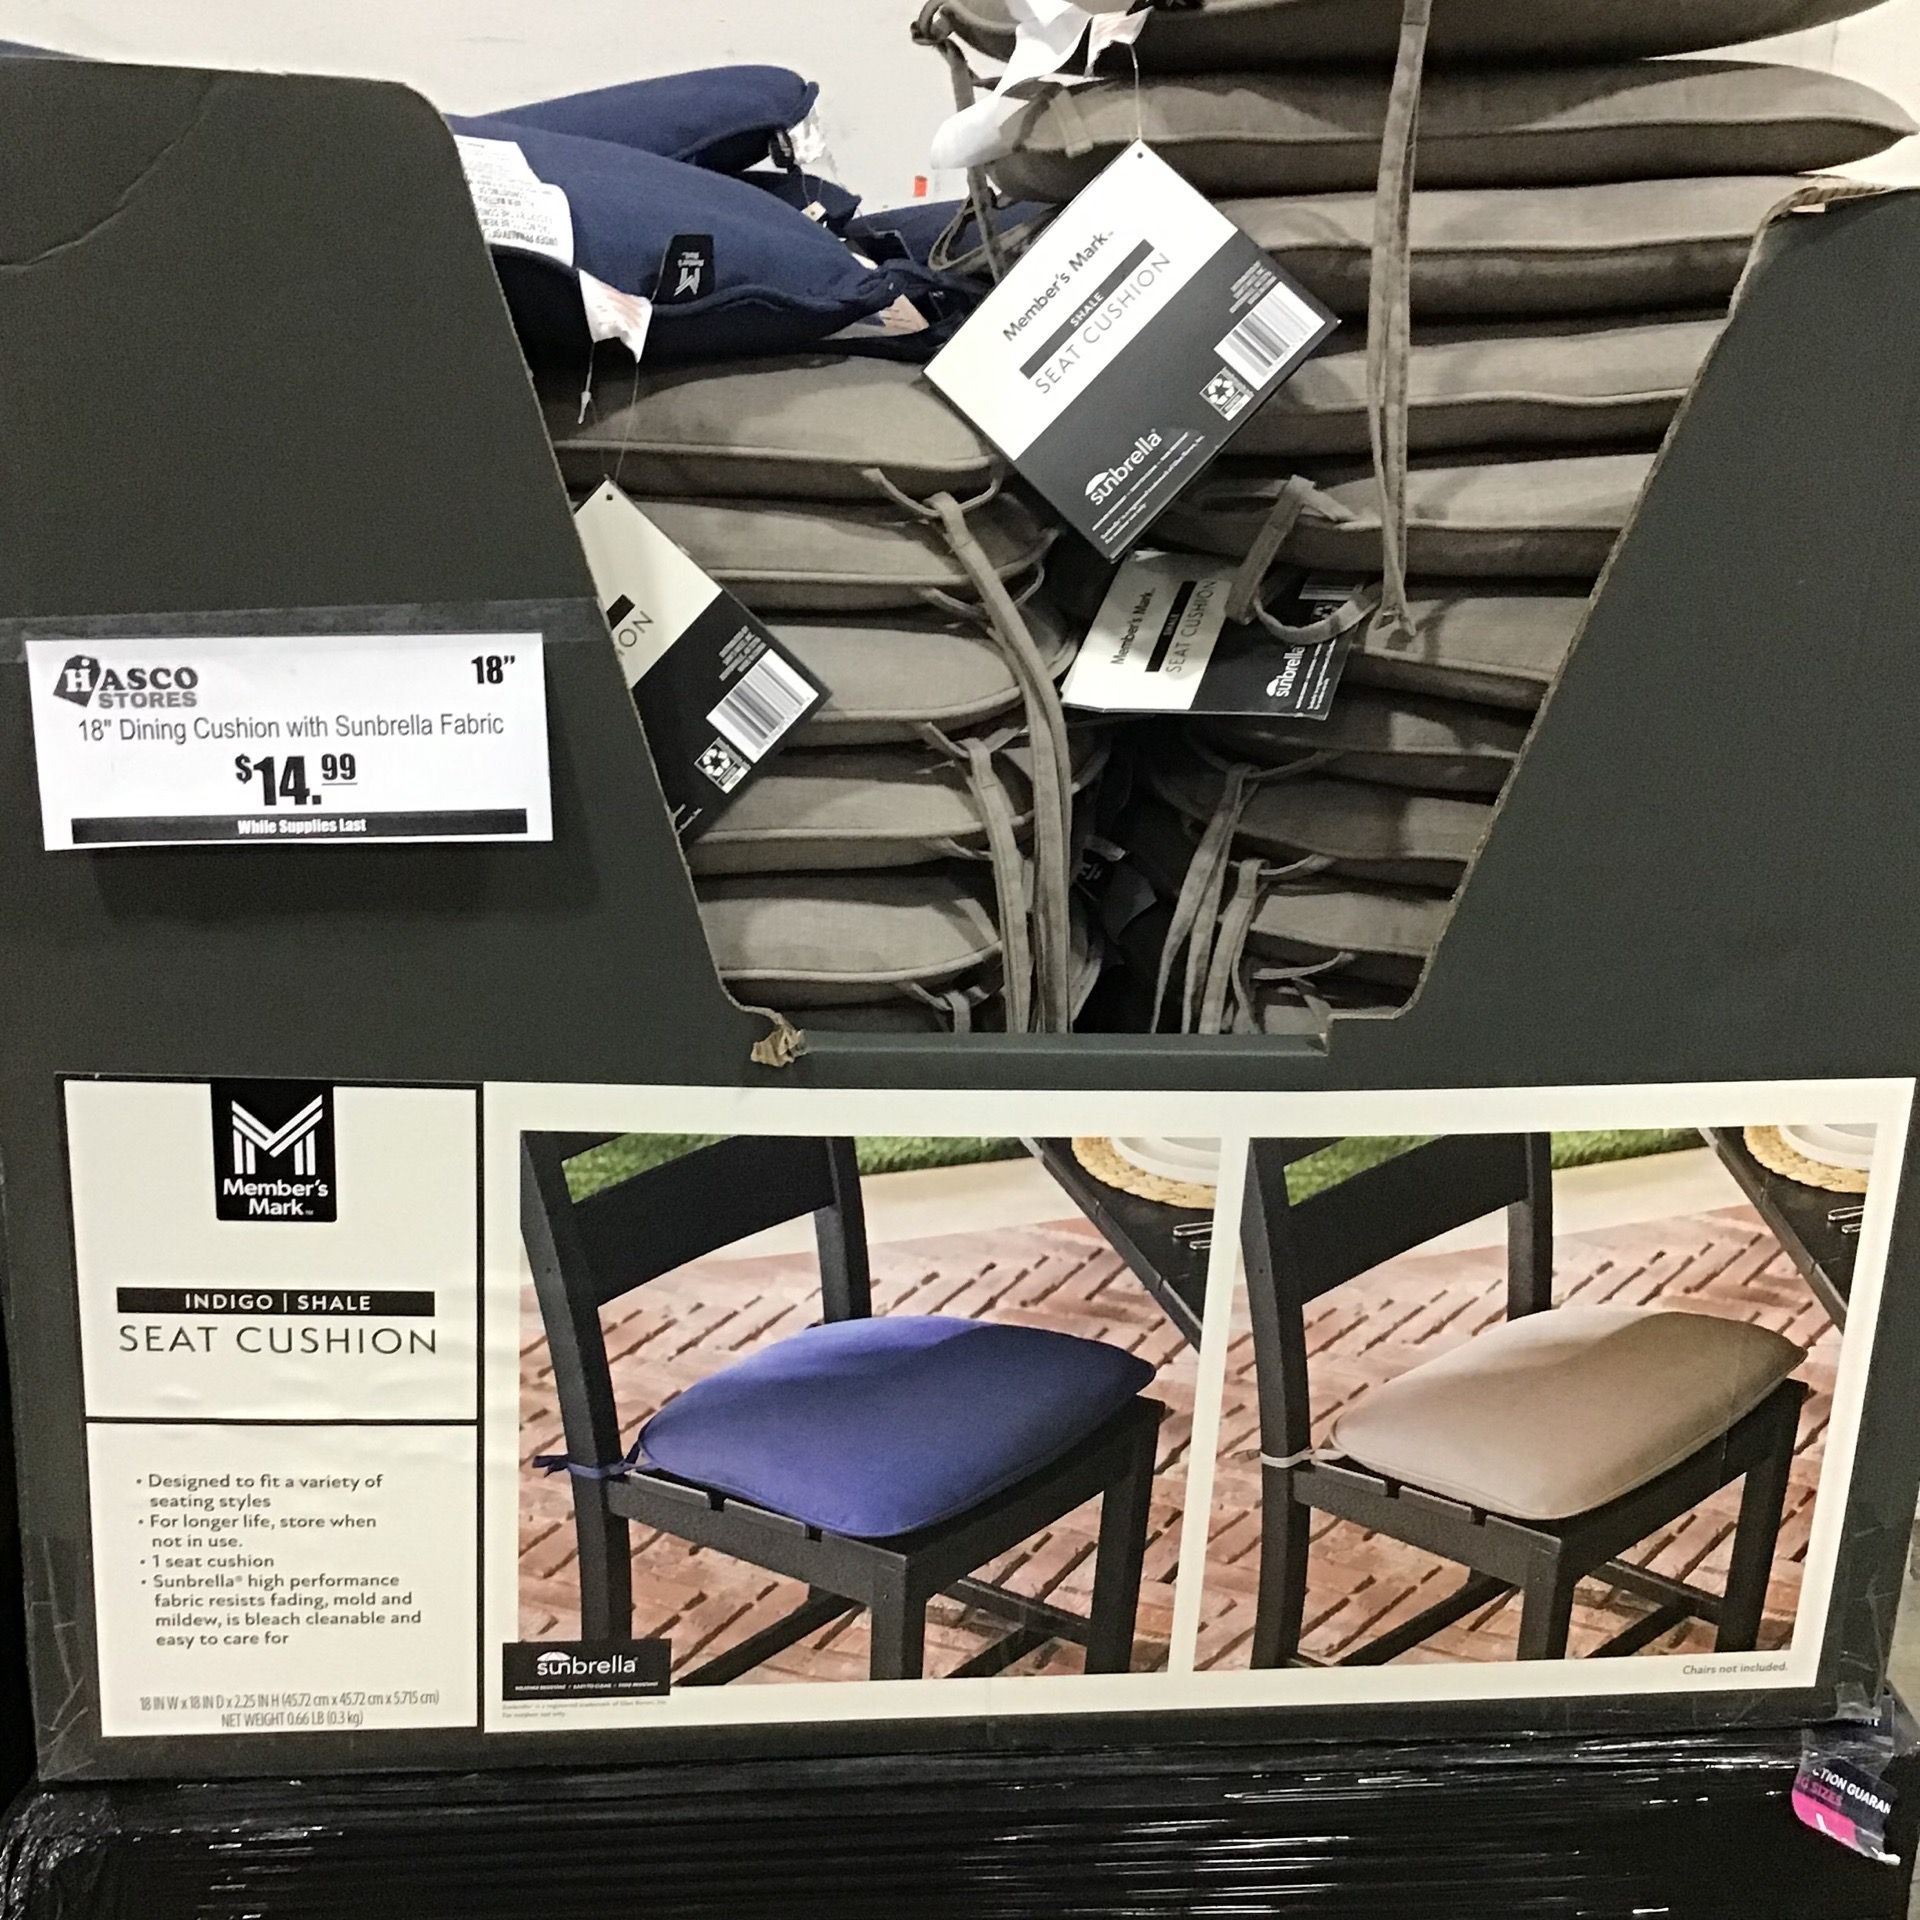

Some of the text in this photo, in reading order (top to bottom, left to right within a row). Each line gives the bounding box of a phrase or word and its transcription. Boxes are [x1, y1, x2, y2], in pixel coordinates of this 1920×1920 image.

[1002, 271, 1071, 342] Member's
[1069, 291, 1105, 328] SHALE
[1035, 252, 1171, 394] SEAT CUSHION
[1085, 432, 1163, 506] sunbrella
[1165, 580, 1216, 673] SEAT CUSHION
[97, 690, 198, 709] STORES
[120, 718, 186, 745] Dining
[194, 717, 280, 739] Cushion
[286, 715, 328, 738] with
[336, 714, 433, 737] Sunbrella
[441, 713, 504, 735] Fabric
[238, 818, 366, 834] While Supplies Last
[223, 1178, 328, 1197] Member's
[185, 1293, 273, 1310] INDIGO
[298, 1295, 370, 1311] SHALE
[120, 1325, 436, 1354] SEAT CUSHION
[149, 1474, 383, 1492] Designed to fit a variety of
[150, 1493, 271, 1512] seating styles
[150, 1514, 376, 1532] For longer life, store when
[152, 1534, 243, 1547] not in use.
[152, 1554, 274, 1568] 1 seat cushion
[248, 1574, 284, 1591] high
[290, 1573, 399, 1591] performance
[155, 1591, 412, 1610] fabric resists fading, mold and
[156, 1610, 421, 1628] mildew, is bleach cleanable and
[156, 1631, 289, 1649] easy to care for
[536, 1655, 637, 1676] sunbrella
[1682, 1661, 1788, 1675] Chairs not included.
[167, 1695, 179, 1710] W
[181, 1699, 188, 1710] x
[215, 1694, 225, 1708] D
[226, 1698, 233, 1708] x
[234, 1694, 256, 1708] 2.25
[257, 1693, 269, 1708] IN
[270, 1692, 280, 1707] H
[313, 1694, 330, 1706] cm
[331, 1696, 338, 1706] x
[367, 1693, 384, 1705] cm
[385, 1694, 392, 1705] x
[420, 1689, 440, 1705] cm)
[221, 1709, 363, 1727] NET WEIGHT 0.66 LB (0.3 kg)
